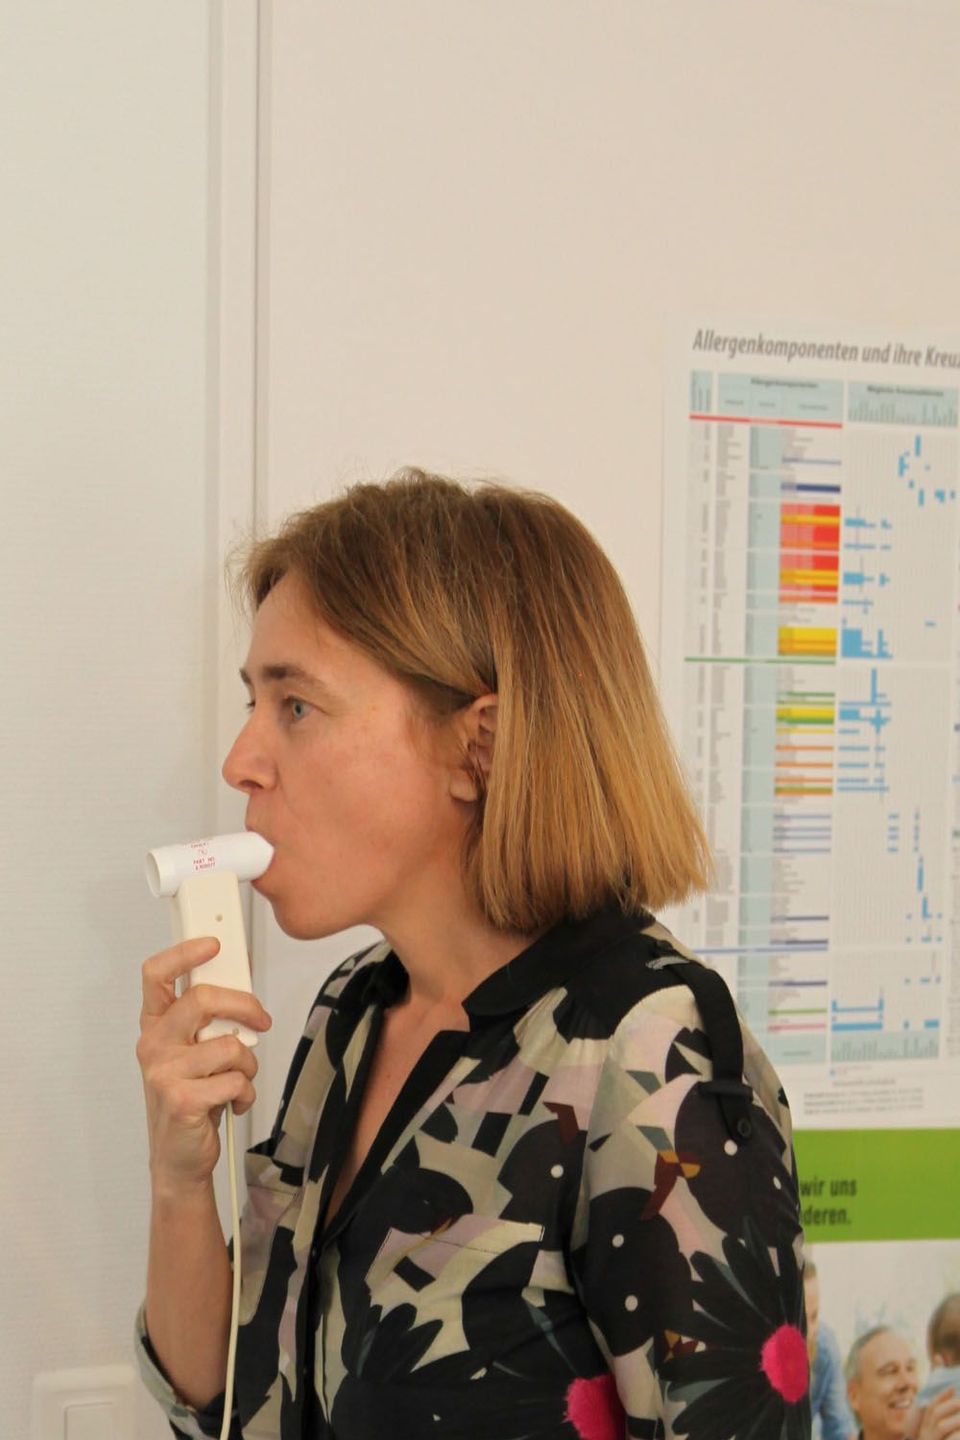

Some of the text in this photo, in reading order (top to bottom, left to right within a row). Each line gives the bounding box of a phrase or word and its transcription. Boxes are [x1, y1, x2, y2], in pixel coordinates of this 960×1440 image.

[692, 329, 859, 363] Allergenkomponenten
[861, 341, 890, 365] und
[892, 343, 922, 367] ihre
[800, 1176, 857, 1198] wir uns
[800, 1205, 852, 1227] deren.
